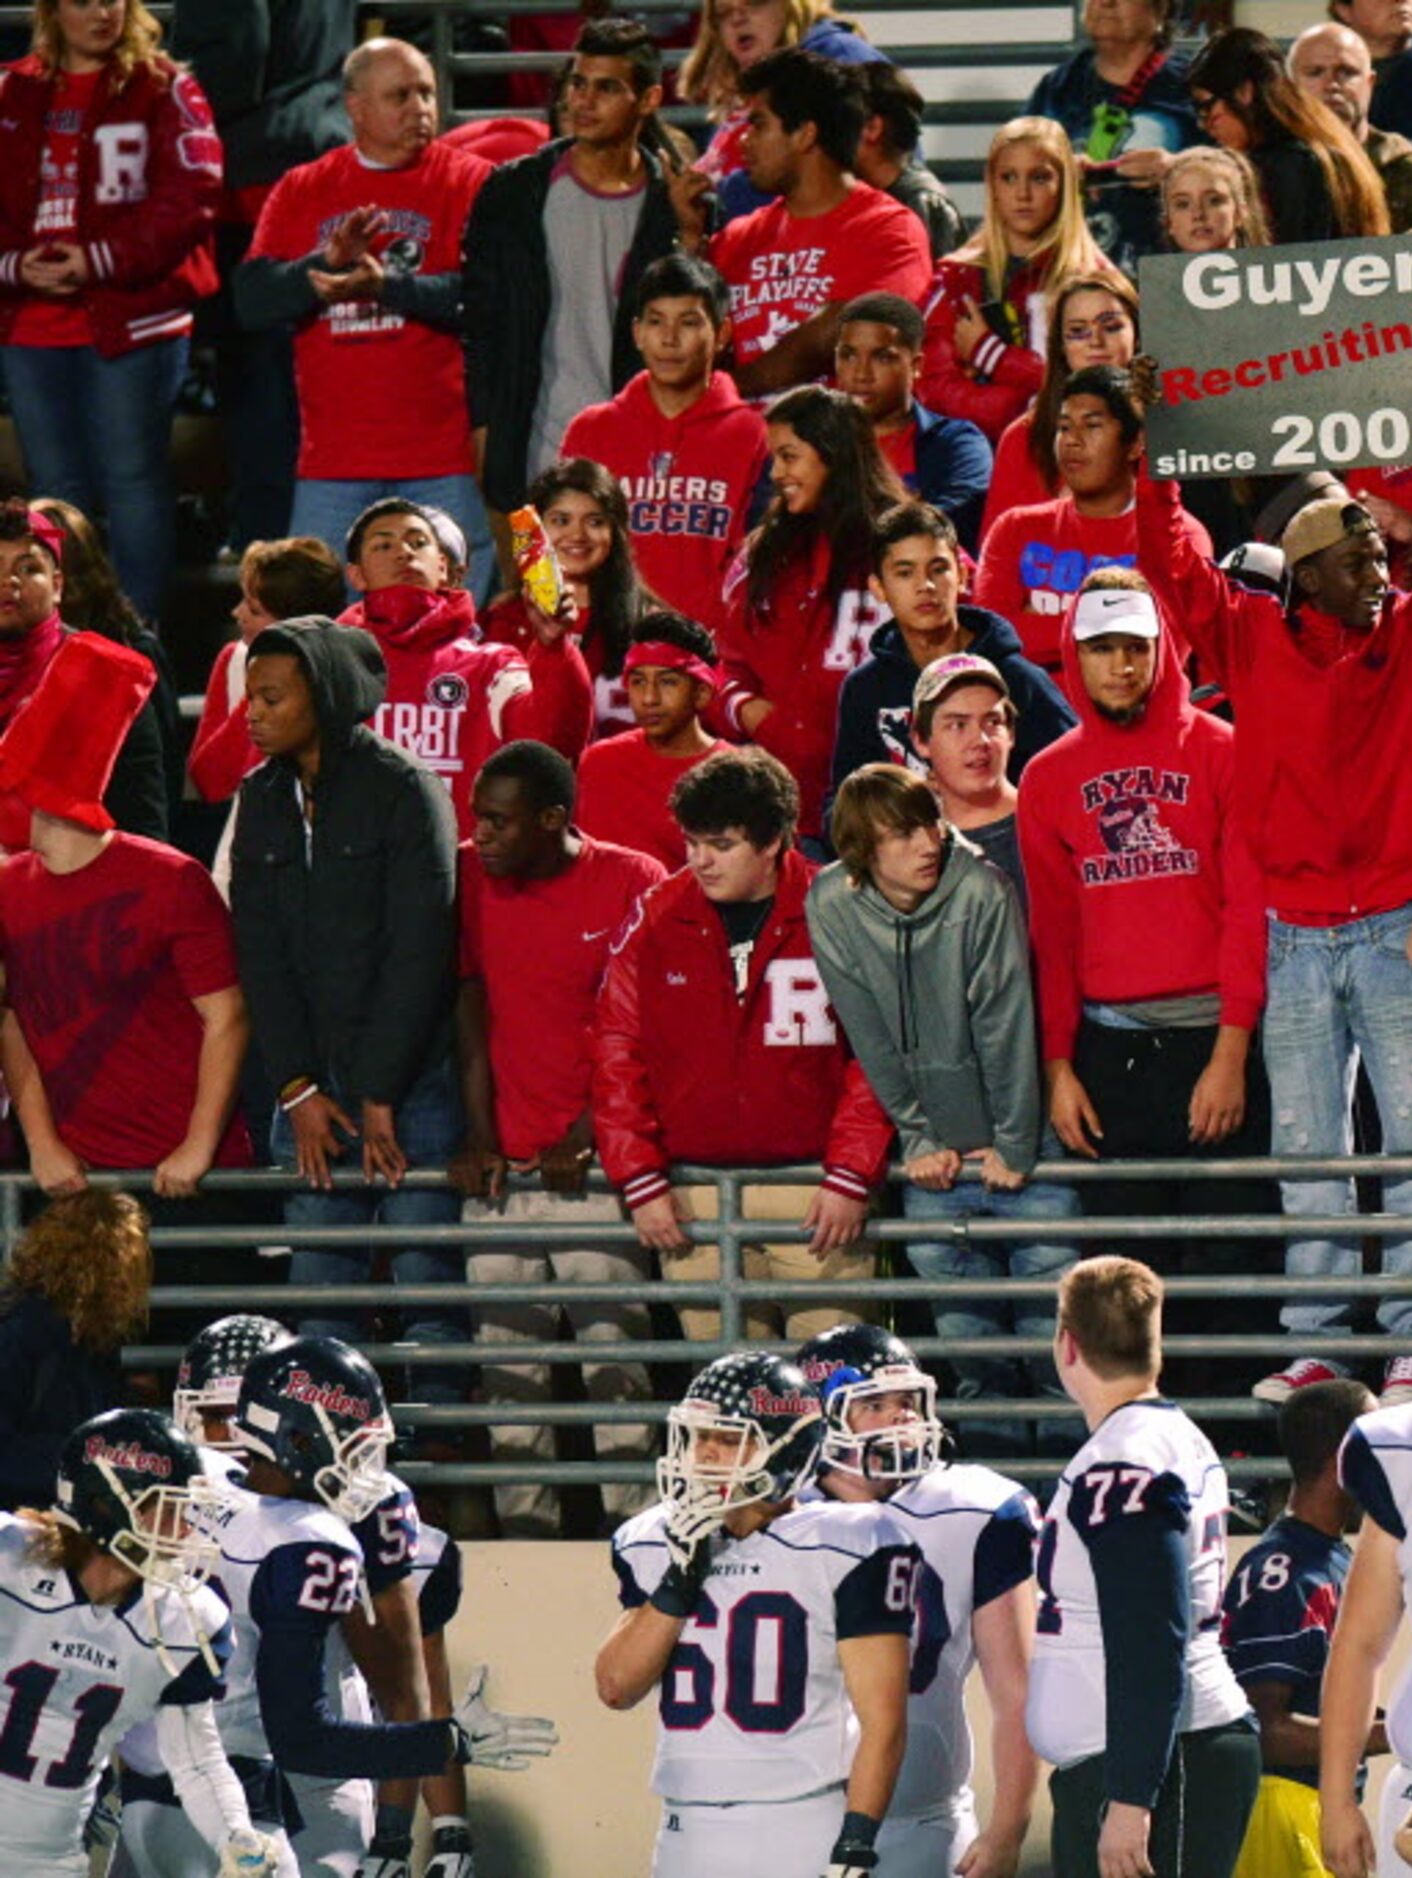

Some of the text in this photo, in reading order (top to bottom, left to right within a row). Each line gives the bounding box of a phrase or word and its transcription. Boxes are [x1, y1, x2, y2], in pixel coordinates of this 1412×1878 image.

[93, 122, 149, 204] R
[620, 475, 729, 503] AIDERS
[1156, 450, 1256, 476] since
[627, 500, 731, 541] CCER
[1080, 766, 1190, 814] RYAN
[763, 958, 835, 1046] R
[280, 1370, 370, 1421] Raiders
[1085, 1468, 1154, 1527] 77
[297, 1550, 360, 1614] 22
[1237, 1552, 1291, 1609] 18
[62, 1641, 110, 1670] RYAN
[659, 1590, 808, 1734] 60
[0, 1659, 124, 1790] 11
